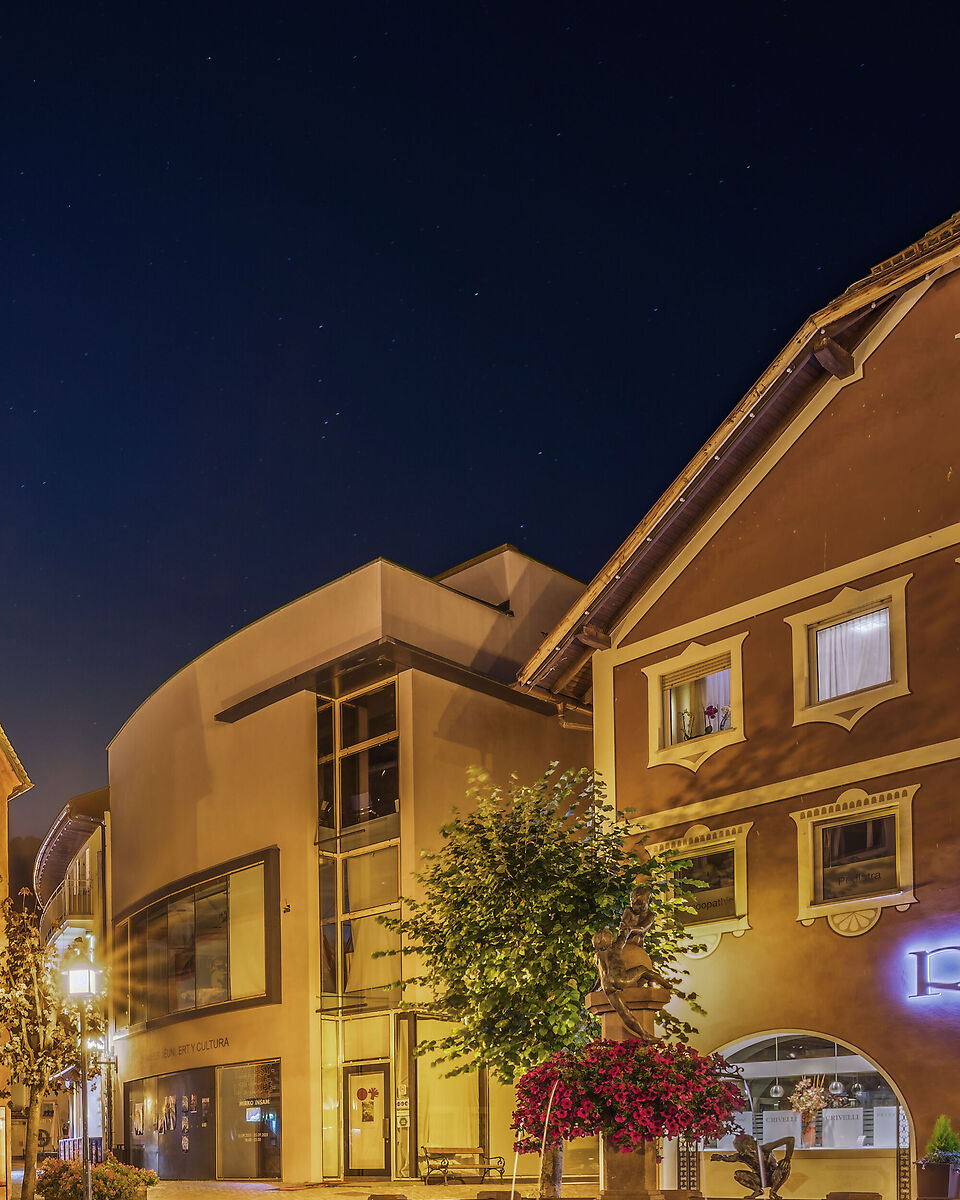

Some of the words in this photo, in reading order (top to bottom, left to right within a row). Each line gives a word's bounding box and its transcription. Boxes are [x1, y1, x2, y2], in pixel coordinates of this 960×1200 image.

[196, 1036, 230, 1052] CULTURA
[765, 1115, 798, 1123] CRIVELLI
[825, 1113, 860, 1121] CRIVELLI
